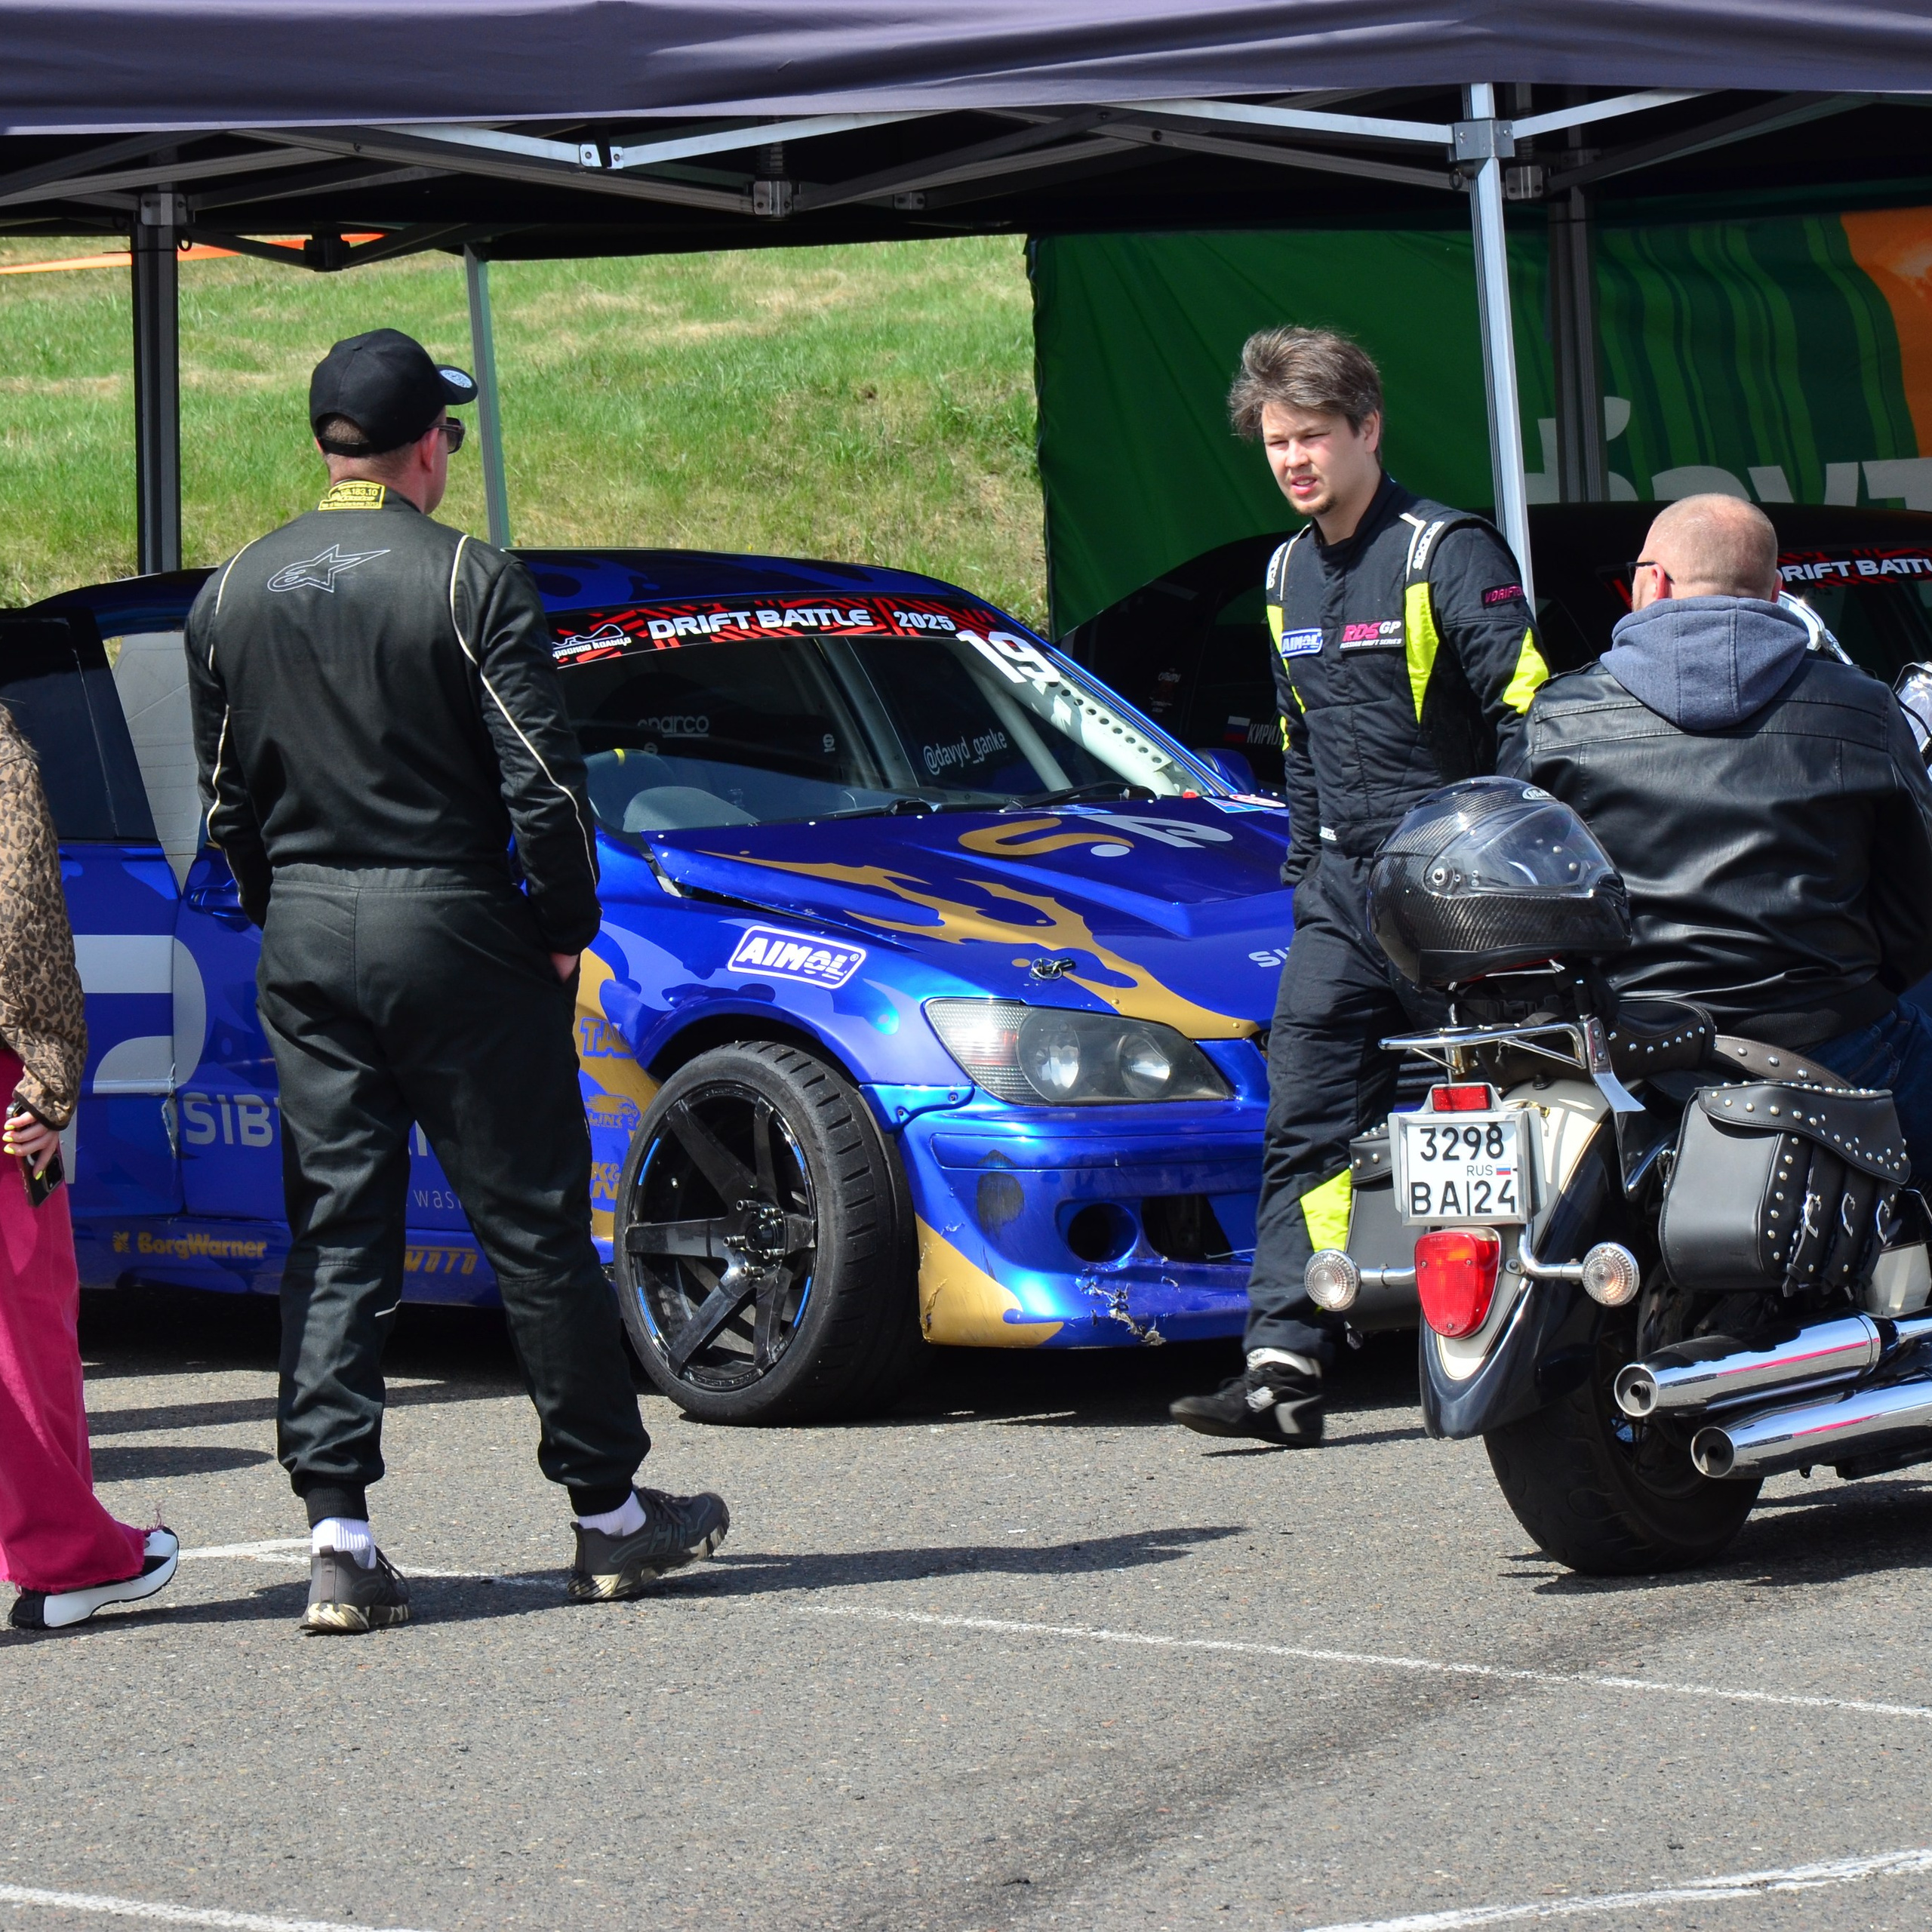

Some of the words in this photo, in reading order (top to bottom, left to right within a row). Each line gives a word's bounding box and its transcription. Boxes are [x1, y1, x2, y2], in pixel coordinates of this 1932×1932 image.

[1777, 561, 1850, 582] RIFT
[648, 611, 750, 639] DRIFT
[755, 609, 873, 627] BATTLE
[894, 611, 956, 631] 2025
[1343, 623, 1380, 641] RDS
[1380, 621, 1401, 634] GP
[955, 630, 1060, 683] 19
[923, 728, 1008, 776] @davyd_ganke
[1248, 947, 1290, 968] SI
[183, 1091, 279, 1147] SIB
[1420, 1126, 1504, 1161] 3298
[1466, 1164, 1493, 1176] RUS
[1411, 1180, 1461, 1215] BA
[1474, 1180, 1515, 1214] 24
[137, 1232, 267, 1260] BorgWarner
